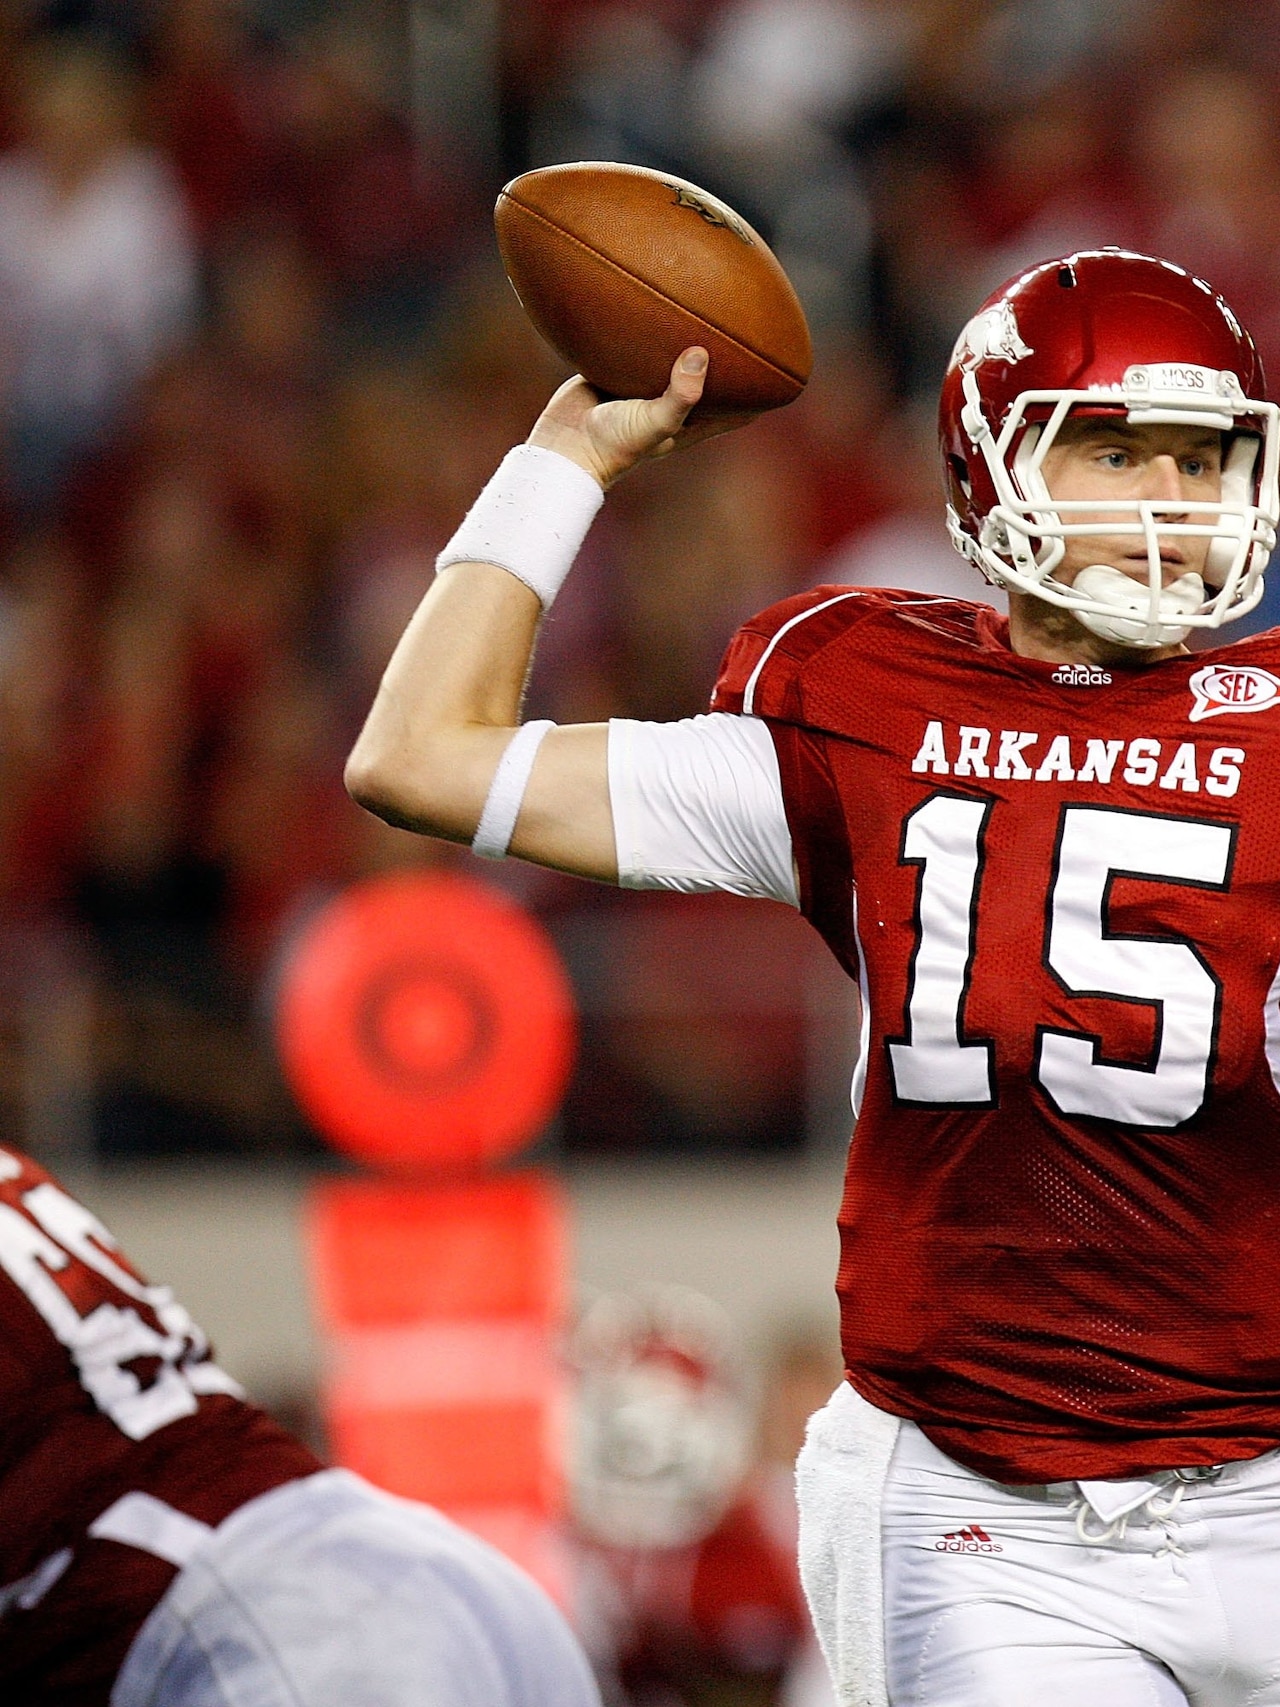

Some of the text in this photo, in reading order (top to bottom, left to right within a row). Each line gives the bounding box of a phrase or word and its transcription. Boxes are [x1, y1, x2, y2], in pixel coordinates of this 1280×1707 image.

[1051, 669, 1112, 685] adidas
[1219, 673, 1258, 702] SEC
[911, 720, 1245, 798] ARKANSAS
[884, 790, 1240, 1133] 15
[935, 1540, 1003, 1552] adidas
